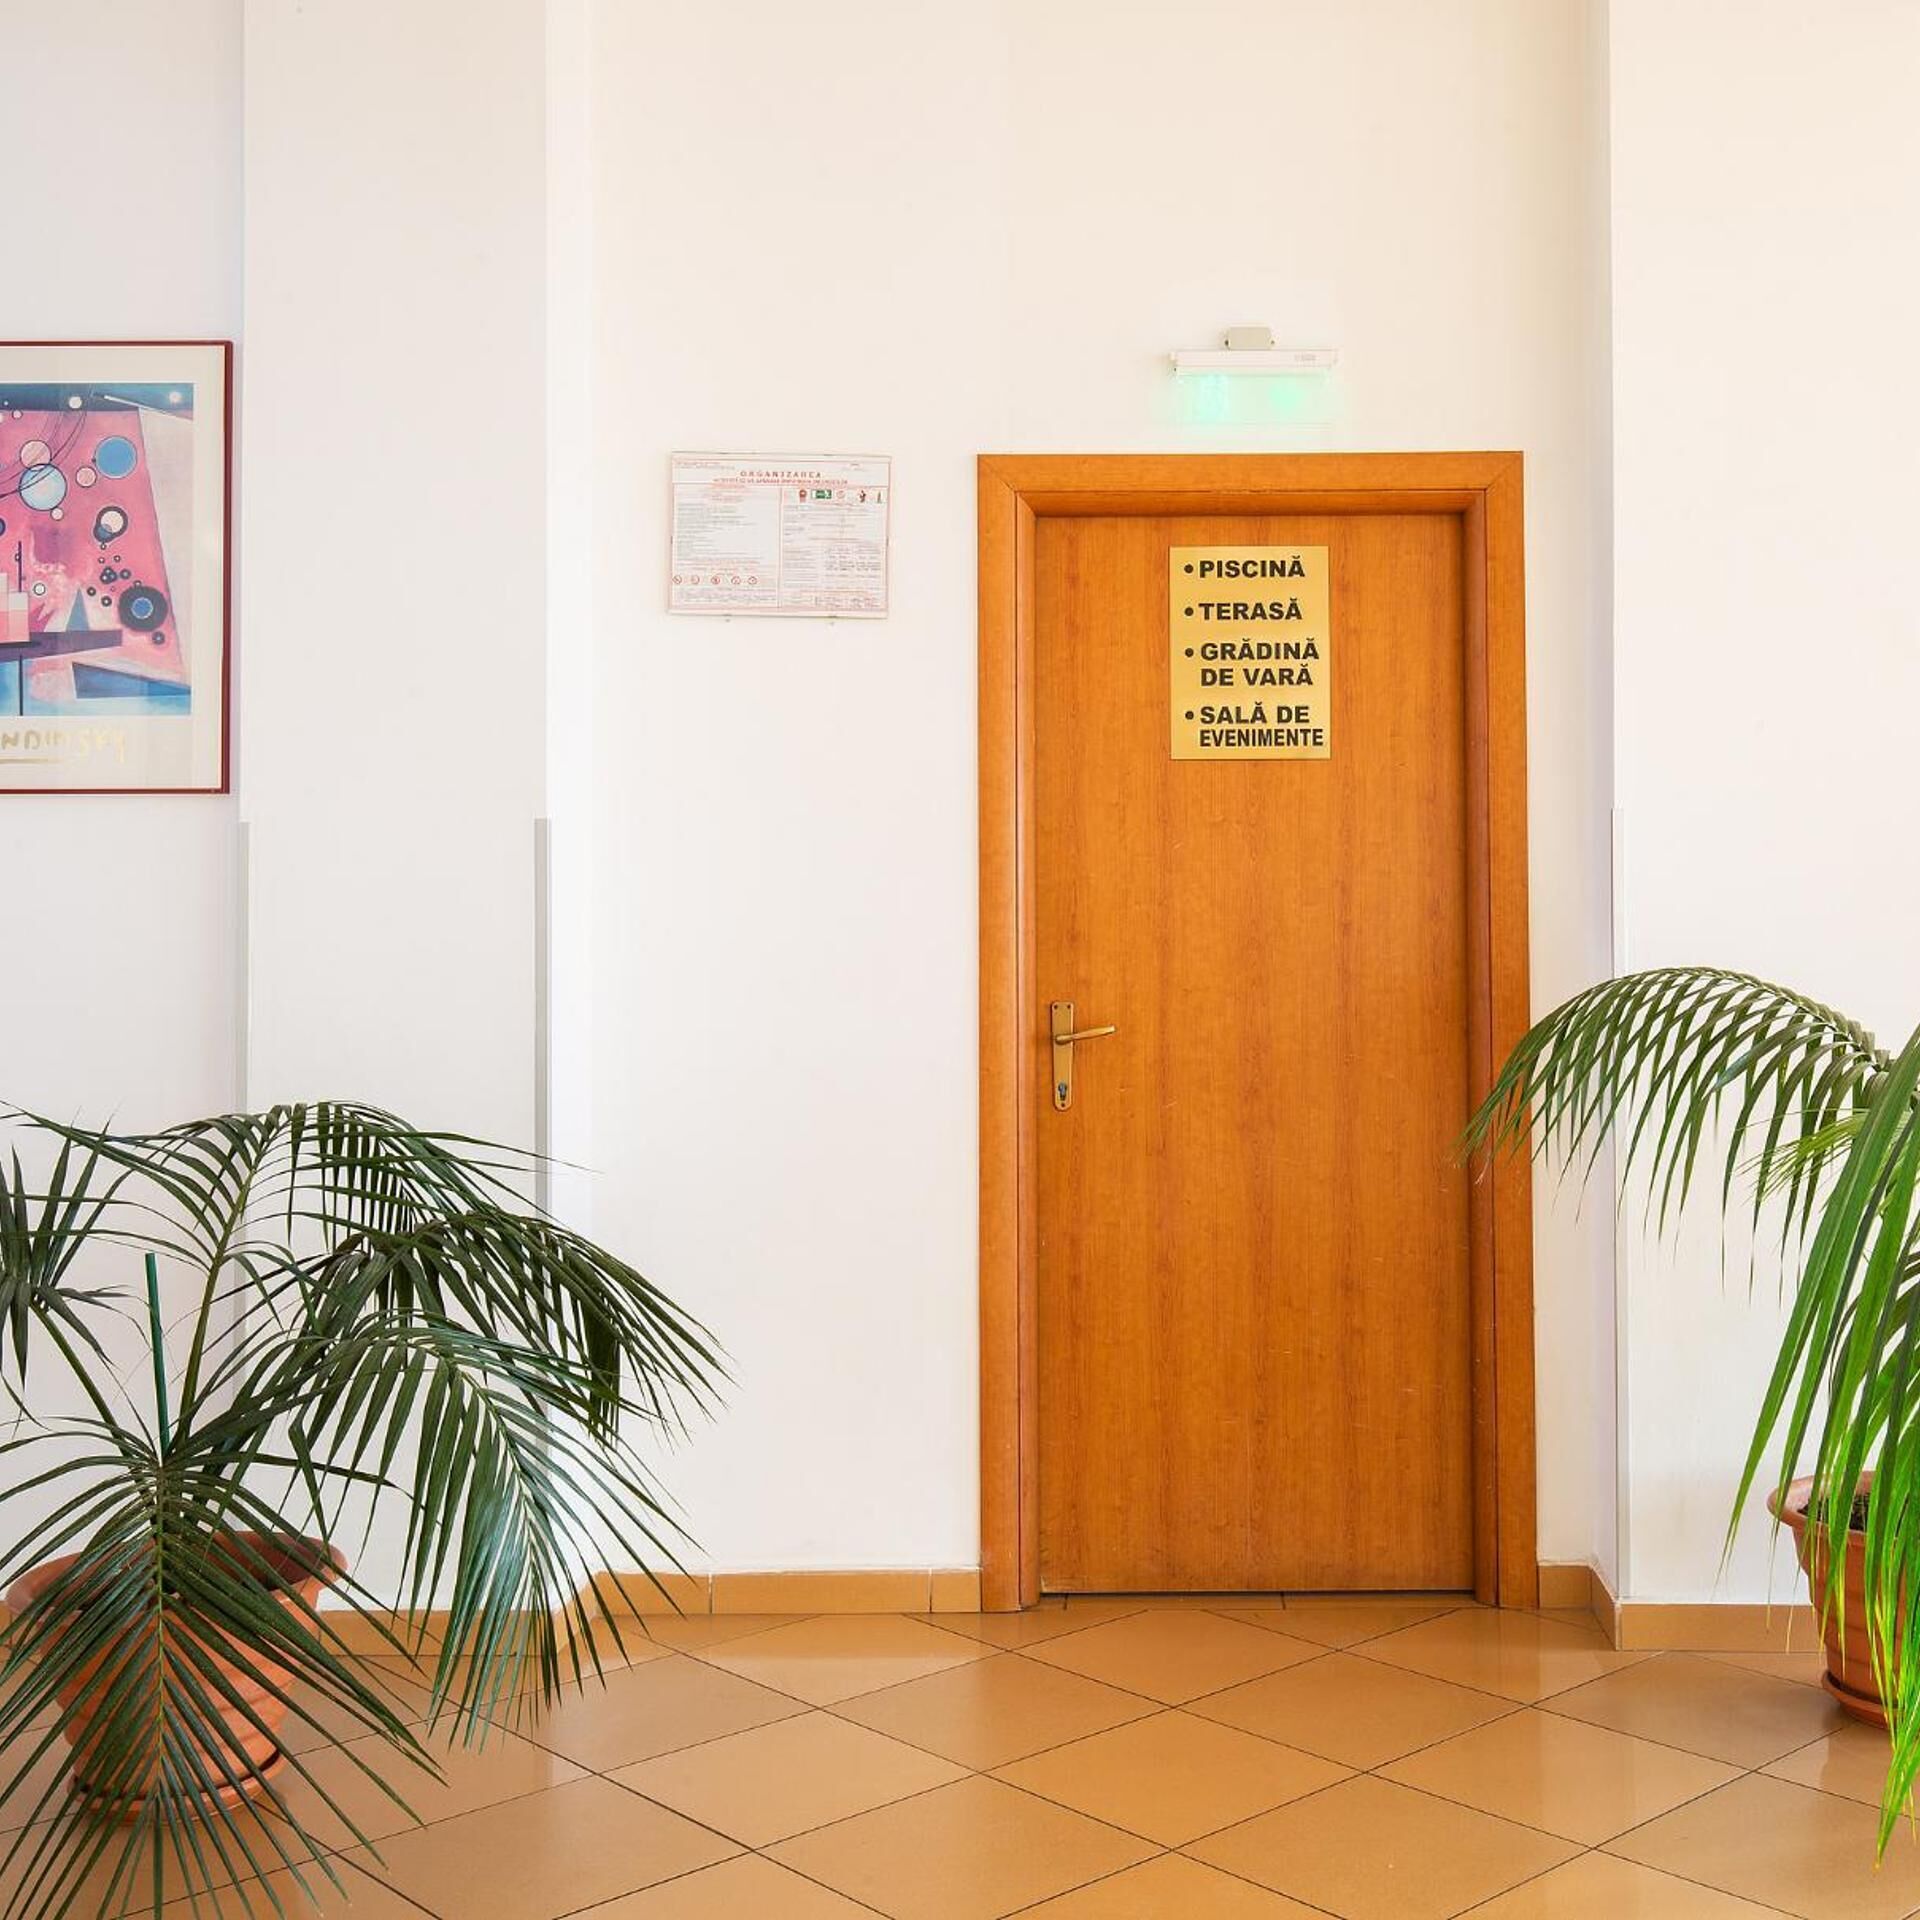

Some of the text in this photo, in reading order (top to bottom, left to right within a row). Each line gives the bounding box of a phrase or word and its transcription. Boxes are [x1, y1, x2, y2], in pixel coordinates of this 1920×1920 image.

[740, 470, 822, 479] ORGANIZAREA
[1199, 555, 1305, 578] PISCINĂ
[1198, 598, 1302, 620] TERASĂ
[1200, 638, 1319, 661] GRĂDINĂ
[1201, 663, 1313, 686] DE VARĂ
[1200, 701, 1310, 724] SALĂ DE
[1200, 728, 1324, 747] EVENIMENTE
